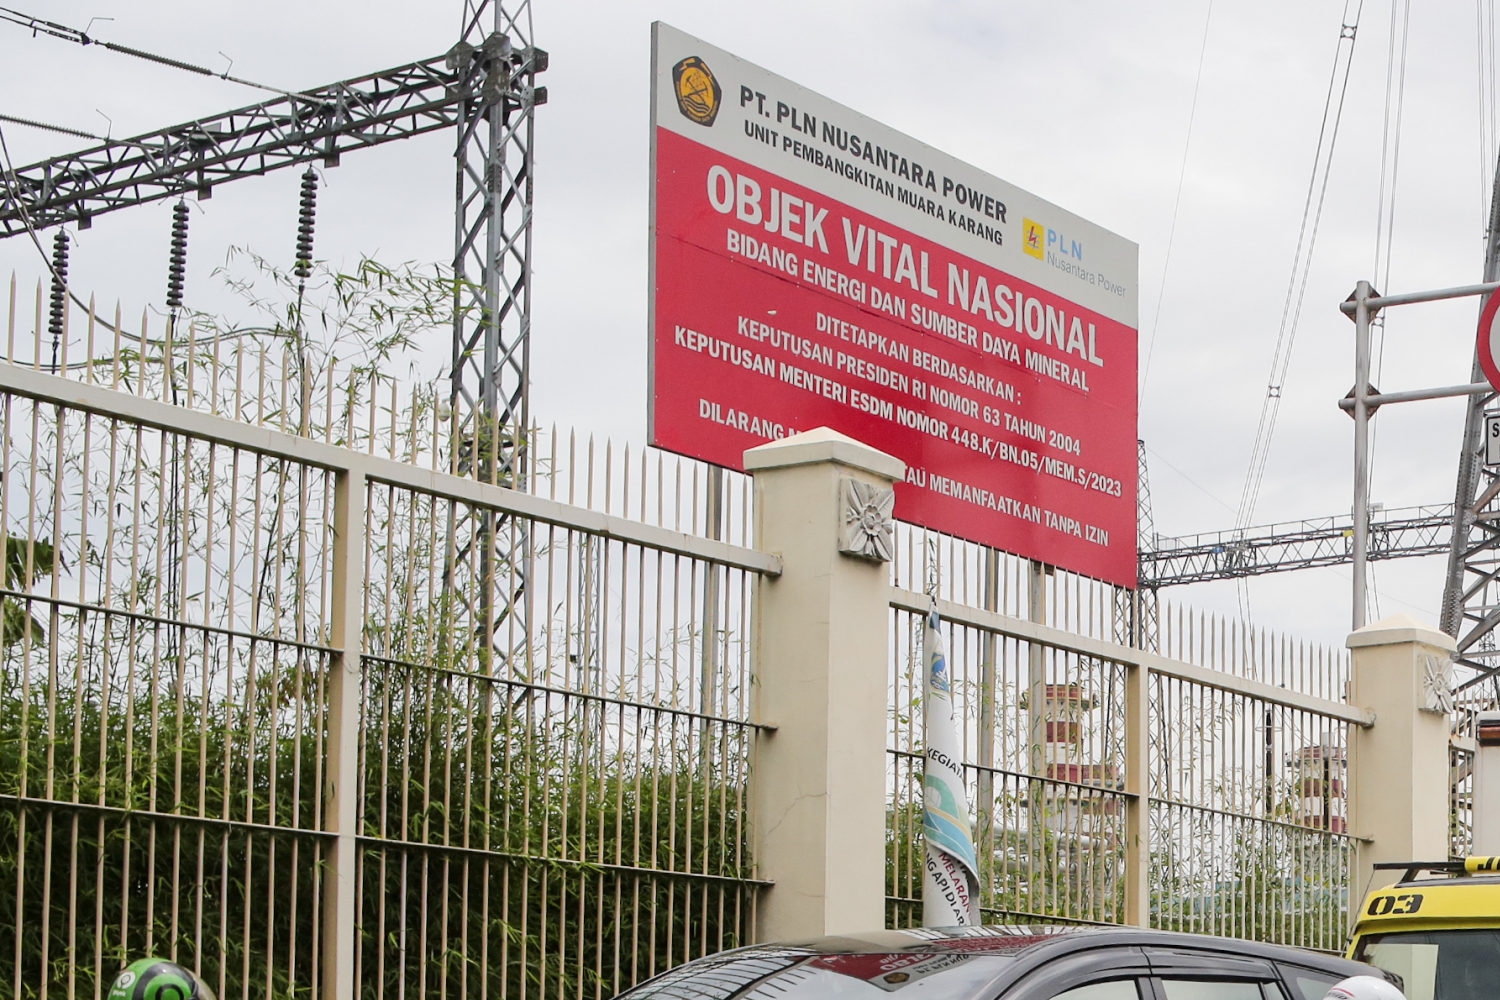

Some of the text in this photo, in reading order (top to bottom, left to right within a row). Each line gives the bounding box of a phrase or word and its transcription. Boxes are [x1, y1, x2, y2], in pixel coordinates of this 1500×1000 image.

[740, 85, 1007, 224] PT. PLN NUSANTARA POWER
[744, 120, 1003, 246] UNIT PEMBANGKITAN MUARA KARANG
[707, 164, 1104, 367] OBJEK VITAL NASIONAL
[727, 228, 1090, 392] BIDANG ENERGI DAN SUMBER DAYA MINERAL
[1047, 228, 1083, 261] PLN
[1047, 252, 1127, 298] Nusantara Power
[674, 325, 1122, 497] KEPUTUSAN MENTERI ESDM NOMOR 448.K/BN.05/MEM.S/2023
[738, 316, 1081, 456] KEPUTUSAN PRESIDEN RI NOMOR 63 TAHUN 2004
[816, 312, 909, 363] DITETAPKAN
[913, 348, 1014, 400] BERDASARKAN
[699, 398, 784, 441] DILARANG
[929, 473, 1041, 524] MEMANFAATKAN
[1044, 510, 1082, 538] TANPA
[1085, 525, 1109, 547] IZIN
[1367, 894, 1424, 916] 03
